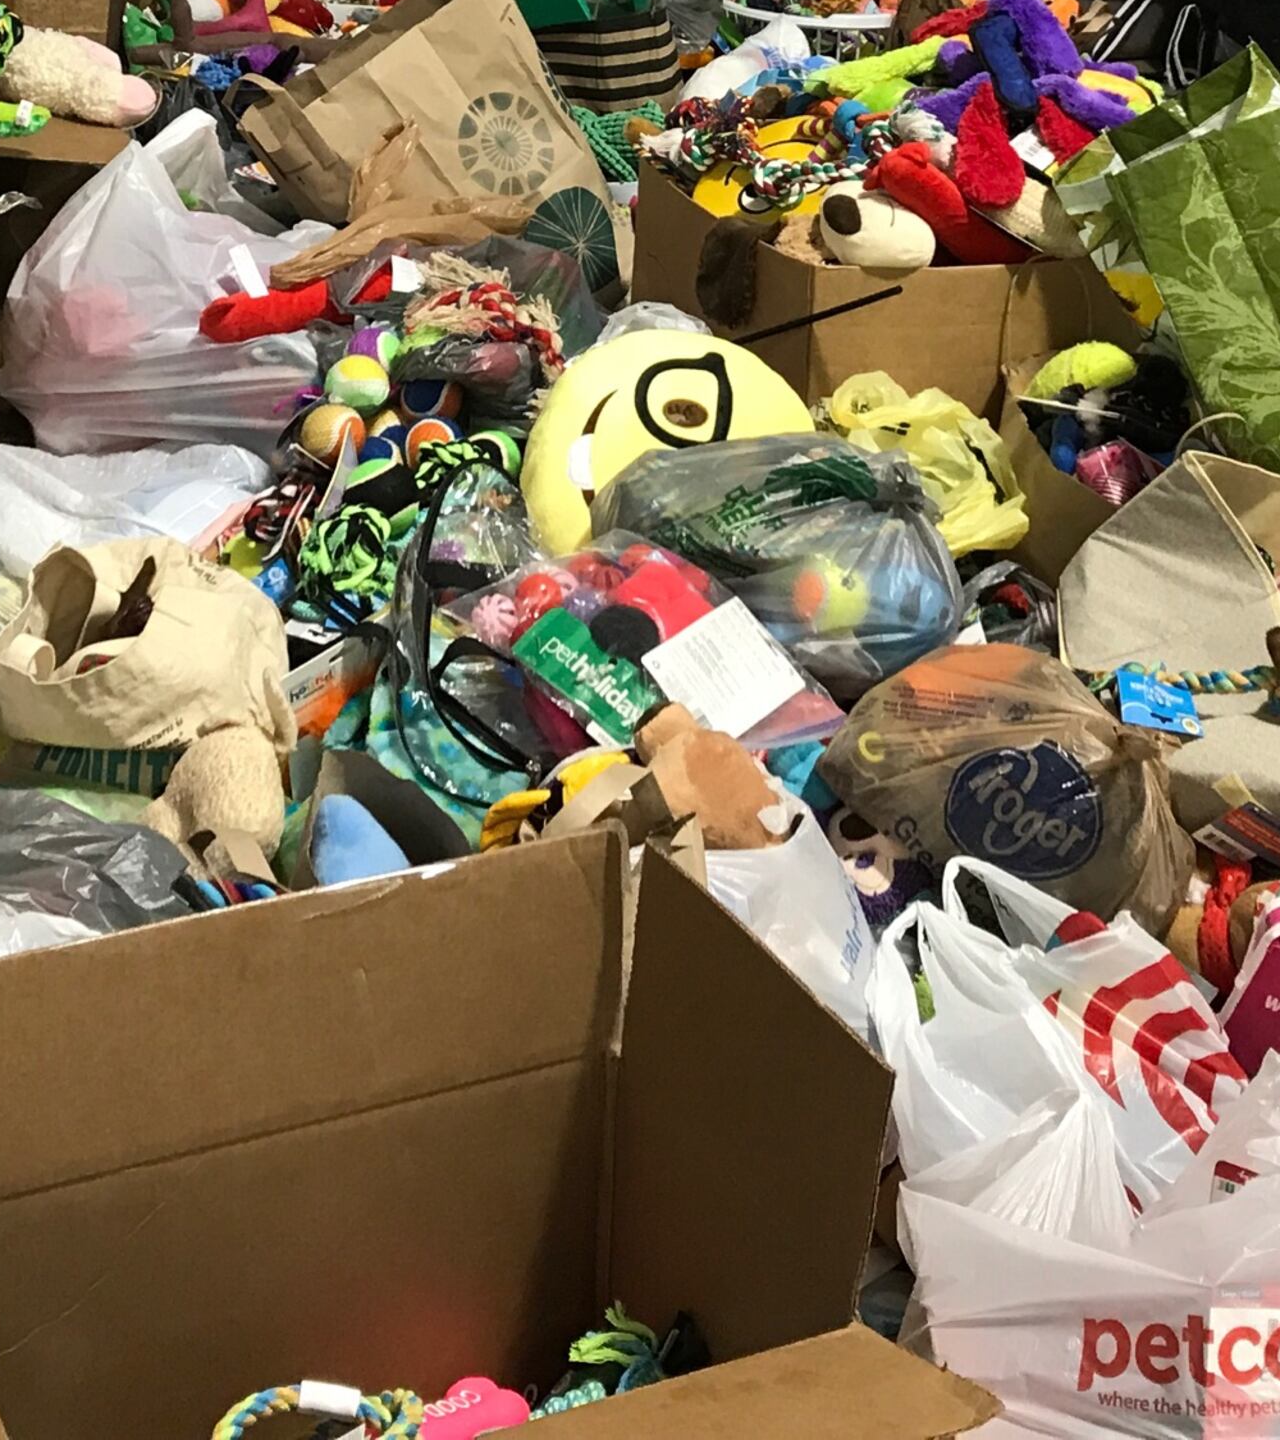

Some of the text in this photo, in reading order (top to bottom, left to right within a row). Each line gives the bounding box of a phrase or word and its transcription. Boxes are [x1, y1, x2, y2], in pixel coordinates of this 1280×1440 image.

[967, 749, 1088, 858] Kroger
[1097, 1389, 1151, 1412] where
[1152, 1396, 1182, 1415] the
[1185, 1398, 1246, 1420] healthy
